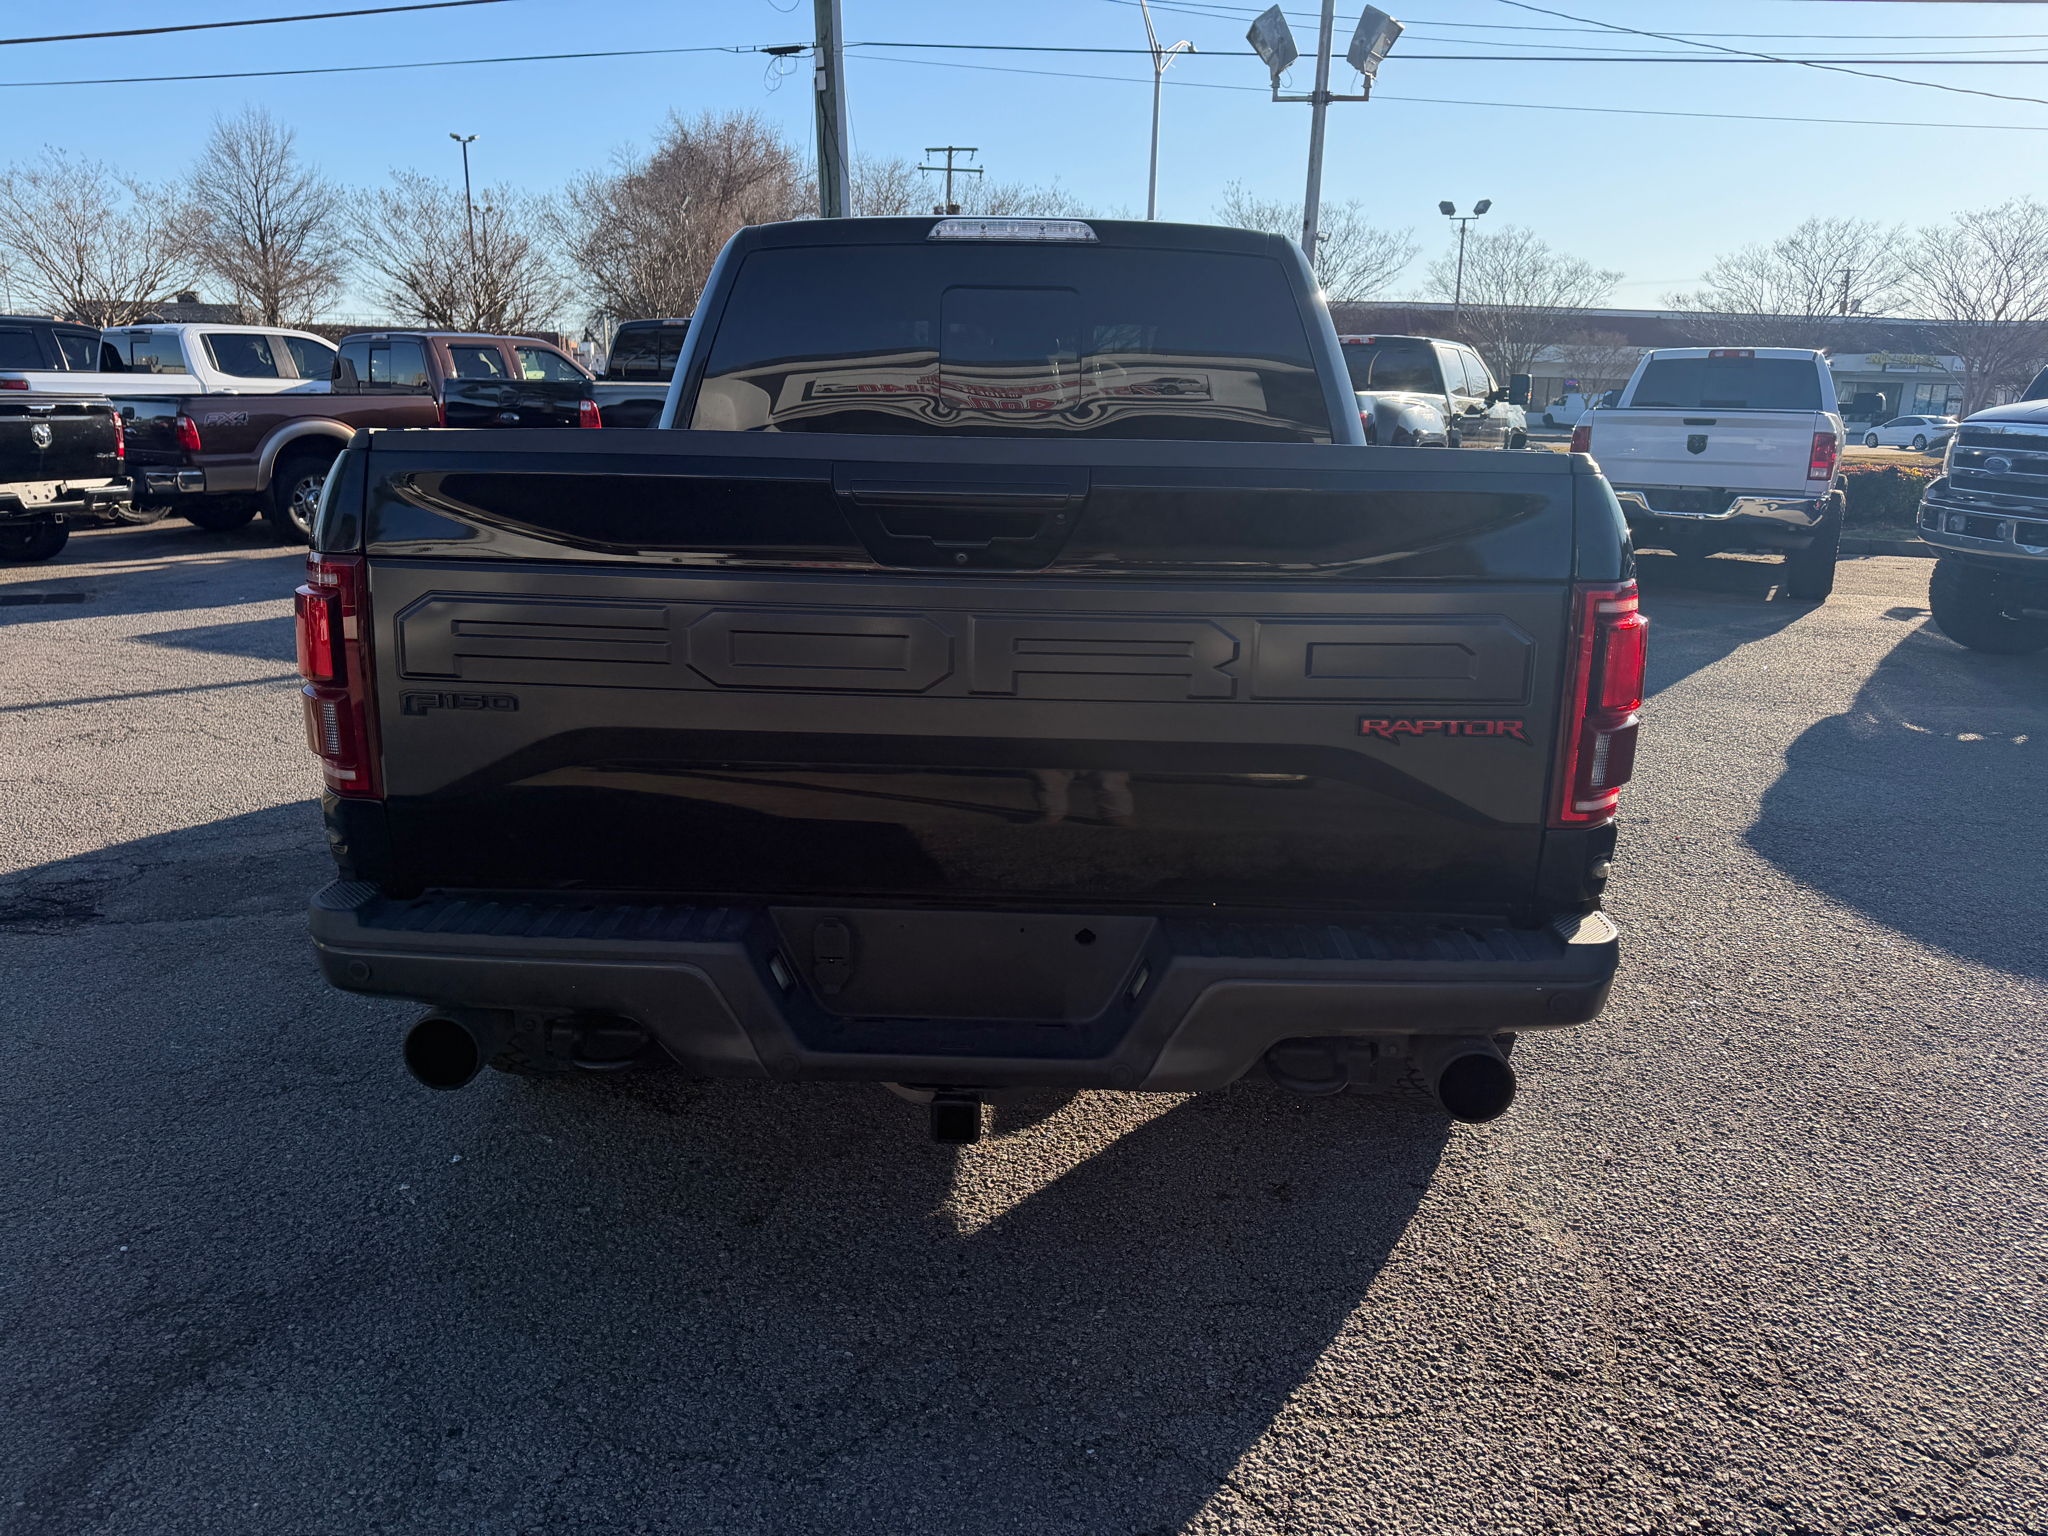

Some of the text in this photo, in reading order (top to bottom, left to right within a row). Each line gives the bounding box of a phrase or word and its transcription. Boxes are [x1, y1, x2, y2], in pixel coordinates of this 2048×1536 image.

[204, 411, 249, 424] FX4
[395, 591, 1534, 703] FORD
[1359, 715, 1530, 745] RAPTOR
